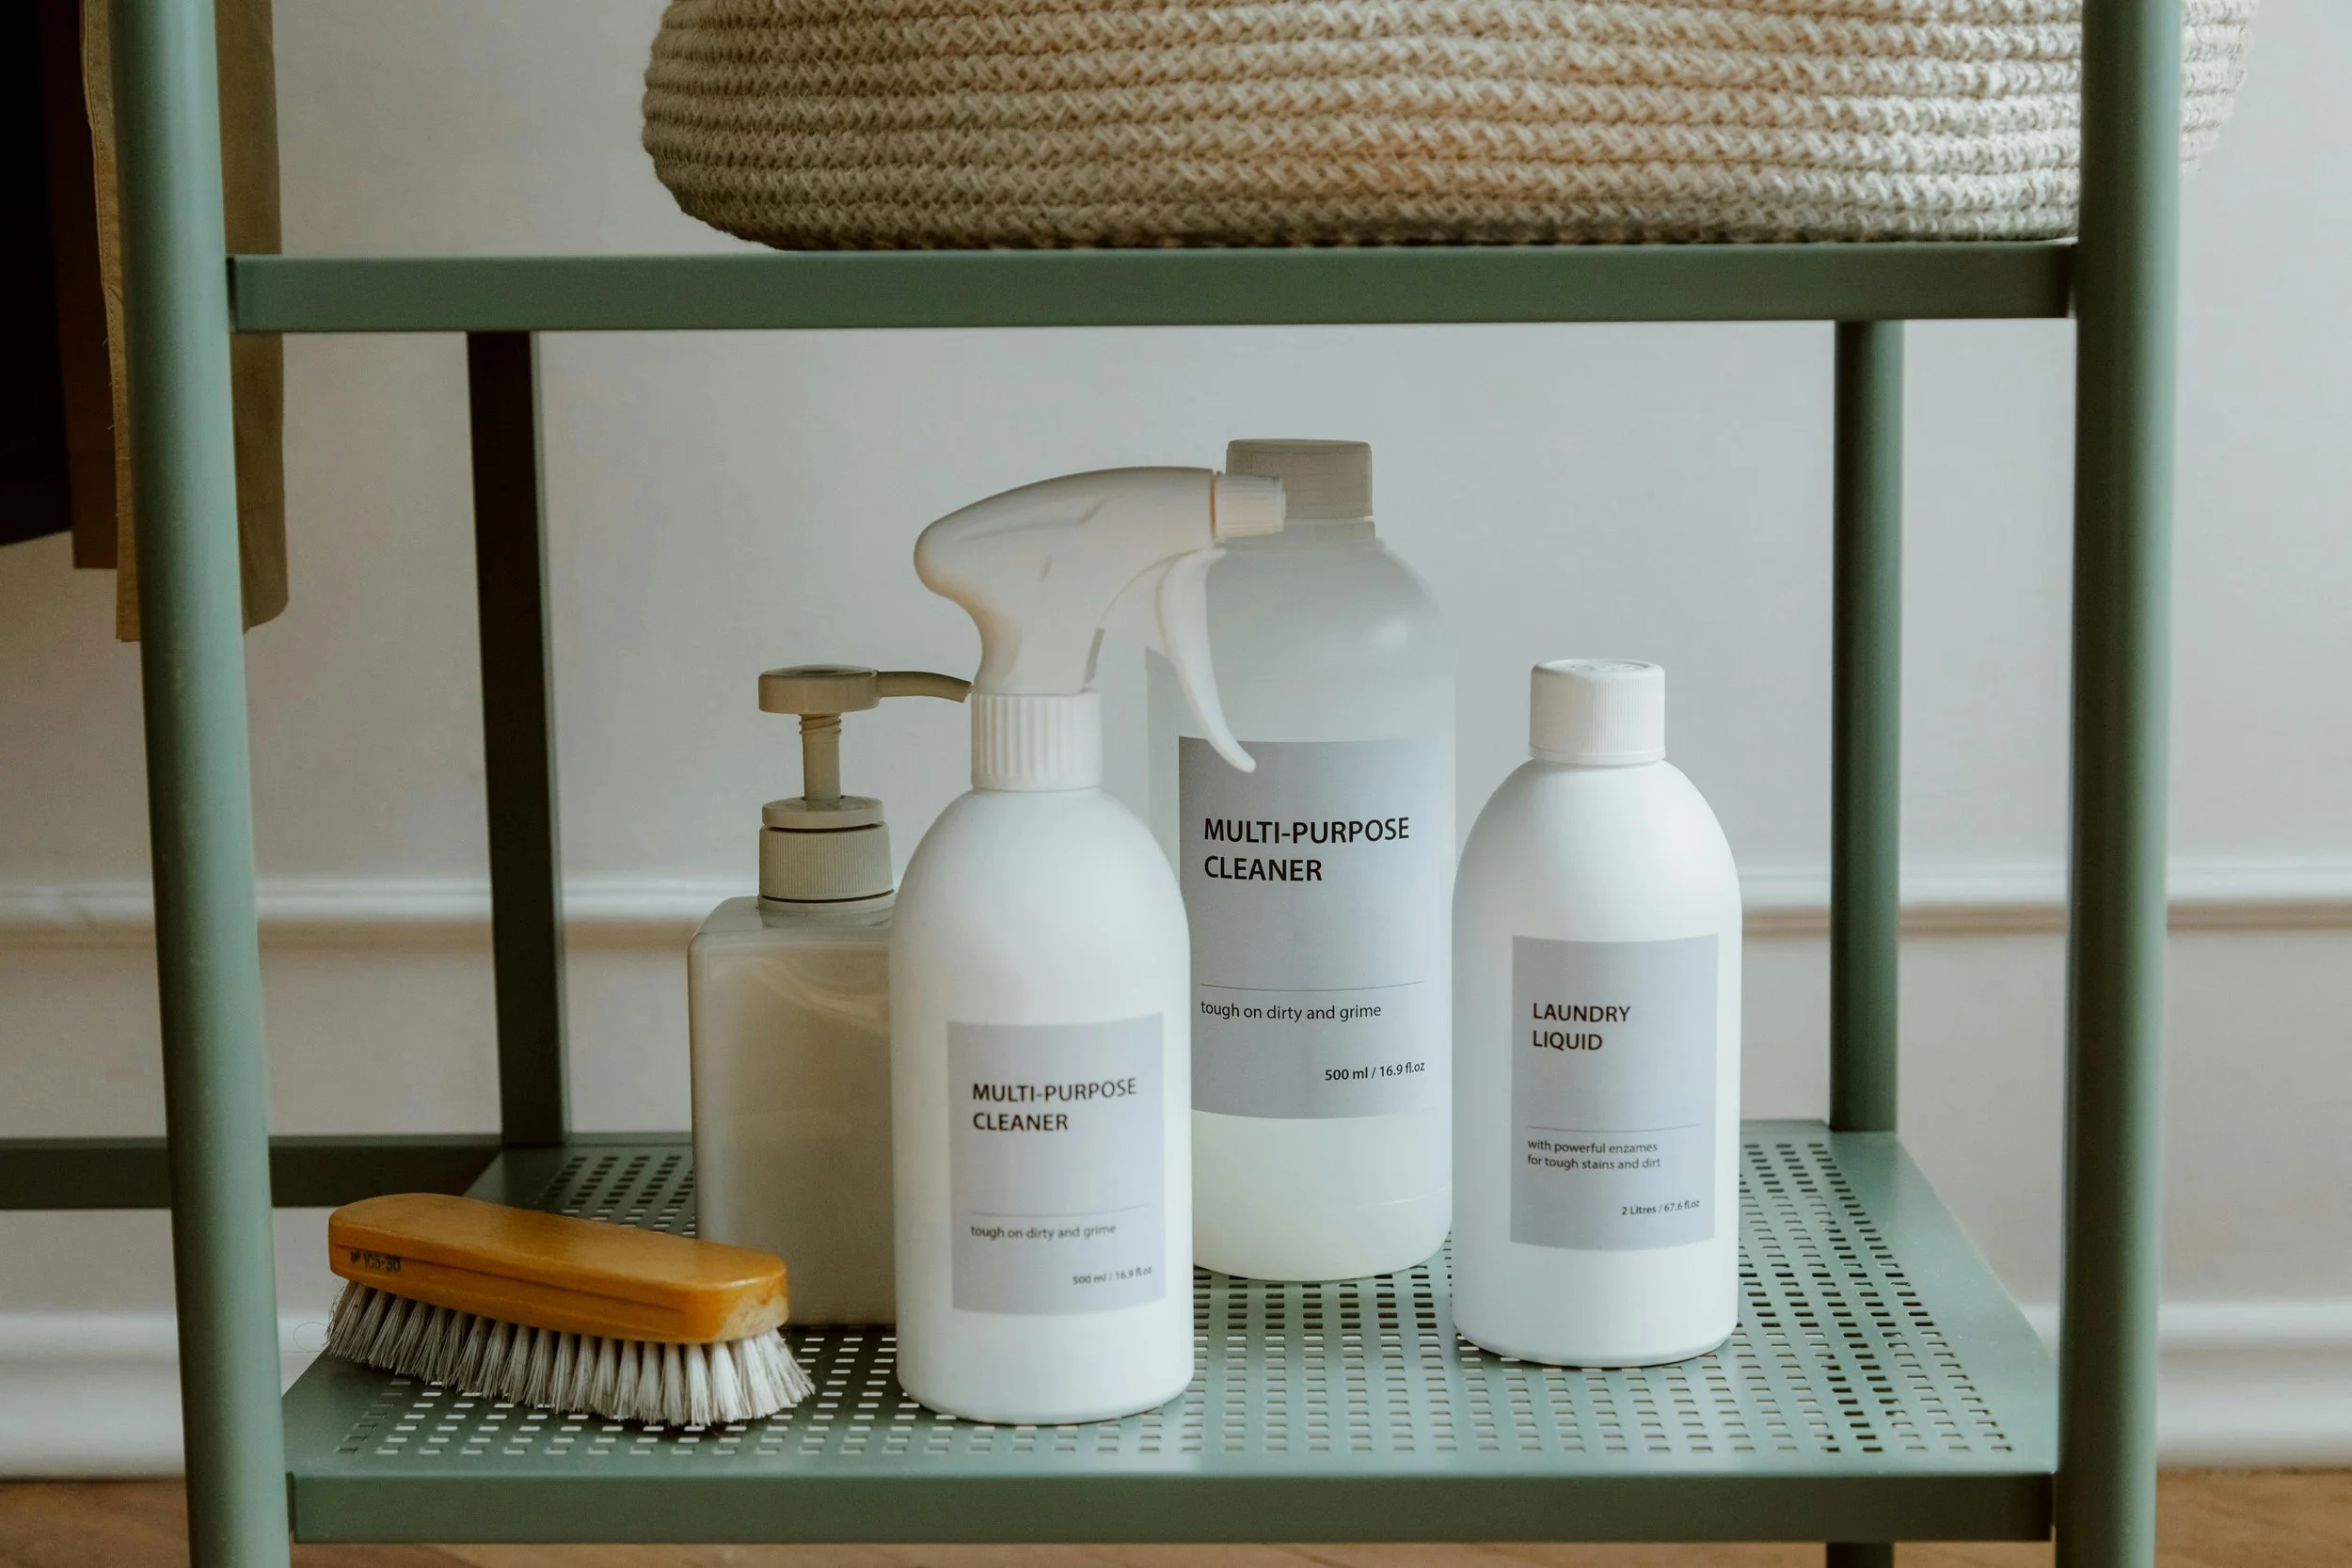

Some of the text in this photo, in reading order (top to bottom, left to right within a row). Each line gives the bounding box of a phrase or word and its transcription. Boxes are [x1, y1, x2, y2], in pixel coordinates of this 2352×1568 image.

[1204, 816, 1410, 845] MULTI-PURPOSE
[1203, 855, 1323, 882] CLEANER
[1200, 1001, 1382, 1023] tough on dirty and grime
[1533, 1002, 1631, 1023] LAUNDRY
[1533, 1029, 1603, 1052] LIQUID
[1325, 1069, 1350, 1081] 500
[1352, 1066, 1369, 1080] ml
[1379, 1063, 1404, 1078] 16.9
[1405, 1061, 1425, 1074] fl.oz
[972, 1077, 1136, 1102] MULTI-PURPOSE
[972, 1112, 1069, 1132] CLEANER
[1527, 1139, 1659, 1154] with powerful enzames
[1527, 1153, 1661, 1171] for tough stains and dirt
[1621, 1206, 1628, 1216] 2
[1629, 1205, 1657, 1215] Litres
[1663, 1201, 1683, 1212] 67.6
[970, 1225, 1117, 1242] tough on dirty and grime
[1072, 1275, 1092, 1286] 500
